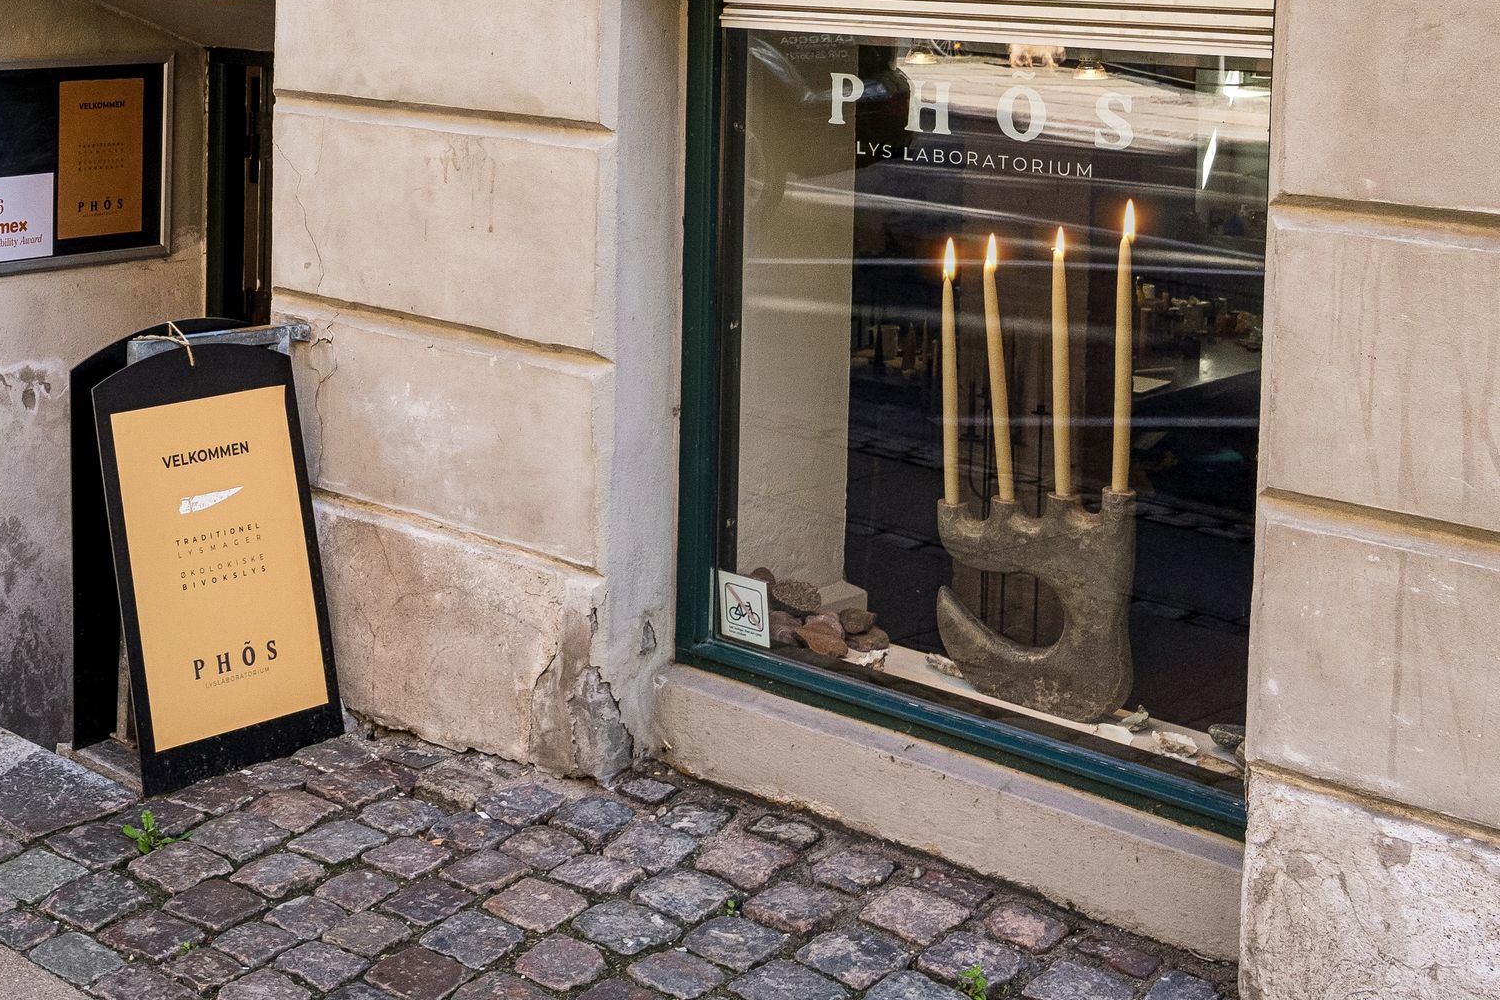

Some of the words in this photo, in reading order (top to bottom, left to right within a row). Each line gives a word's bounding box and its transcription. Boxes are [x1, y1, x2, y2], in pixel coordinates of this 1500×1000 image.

[79, 101, 125, 110] VELKOMMEN
[856, 140, 892, 158] LYS
[904, 149, 1093, 178] LABORATORIUM
[20, 233, 43, 246] Award
[162, 441, 250, 469] VELKOMMEN
[176, 523, 260, 547] TRADITIONEL
[177, 534, 261, 559] LYSMAGER
[182, 565, 267, 591] BIVOKSLYS
[205, 667, 270, 689] LYSLABORATORIUM
